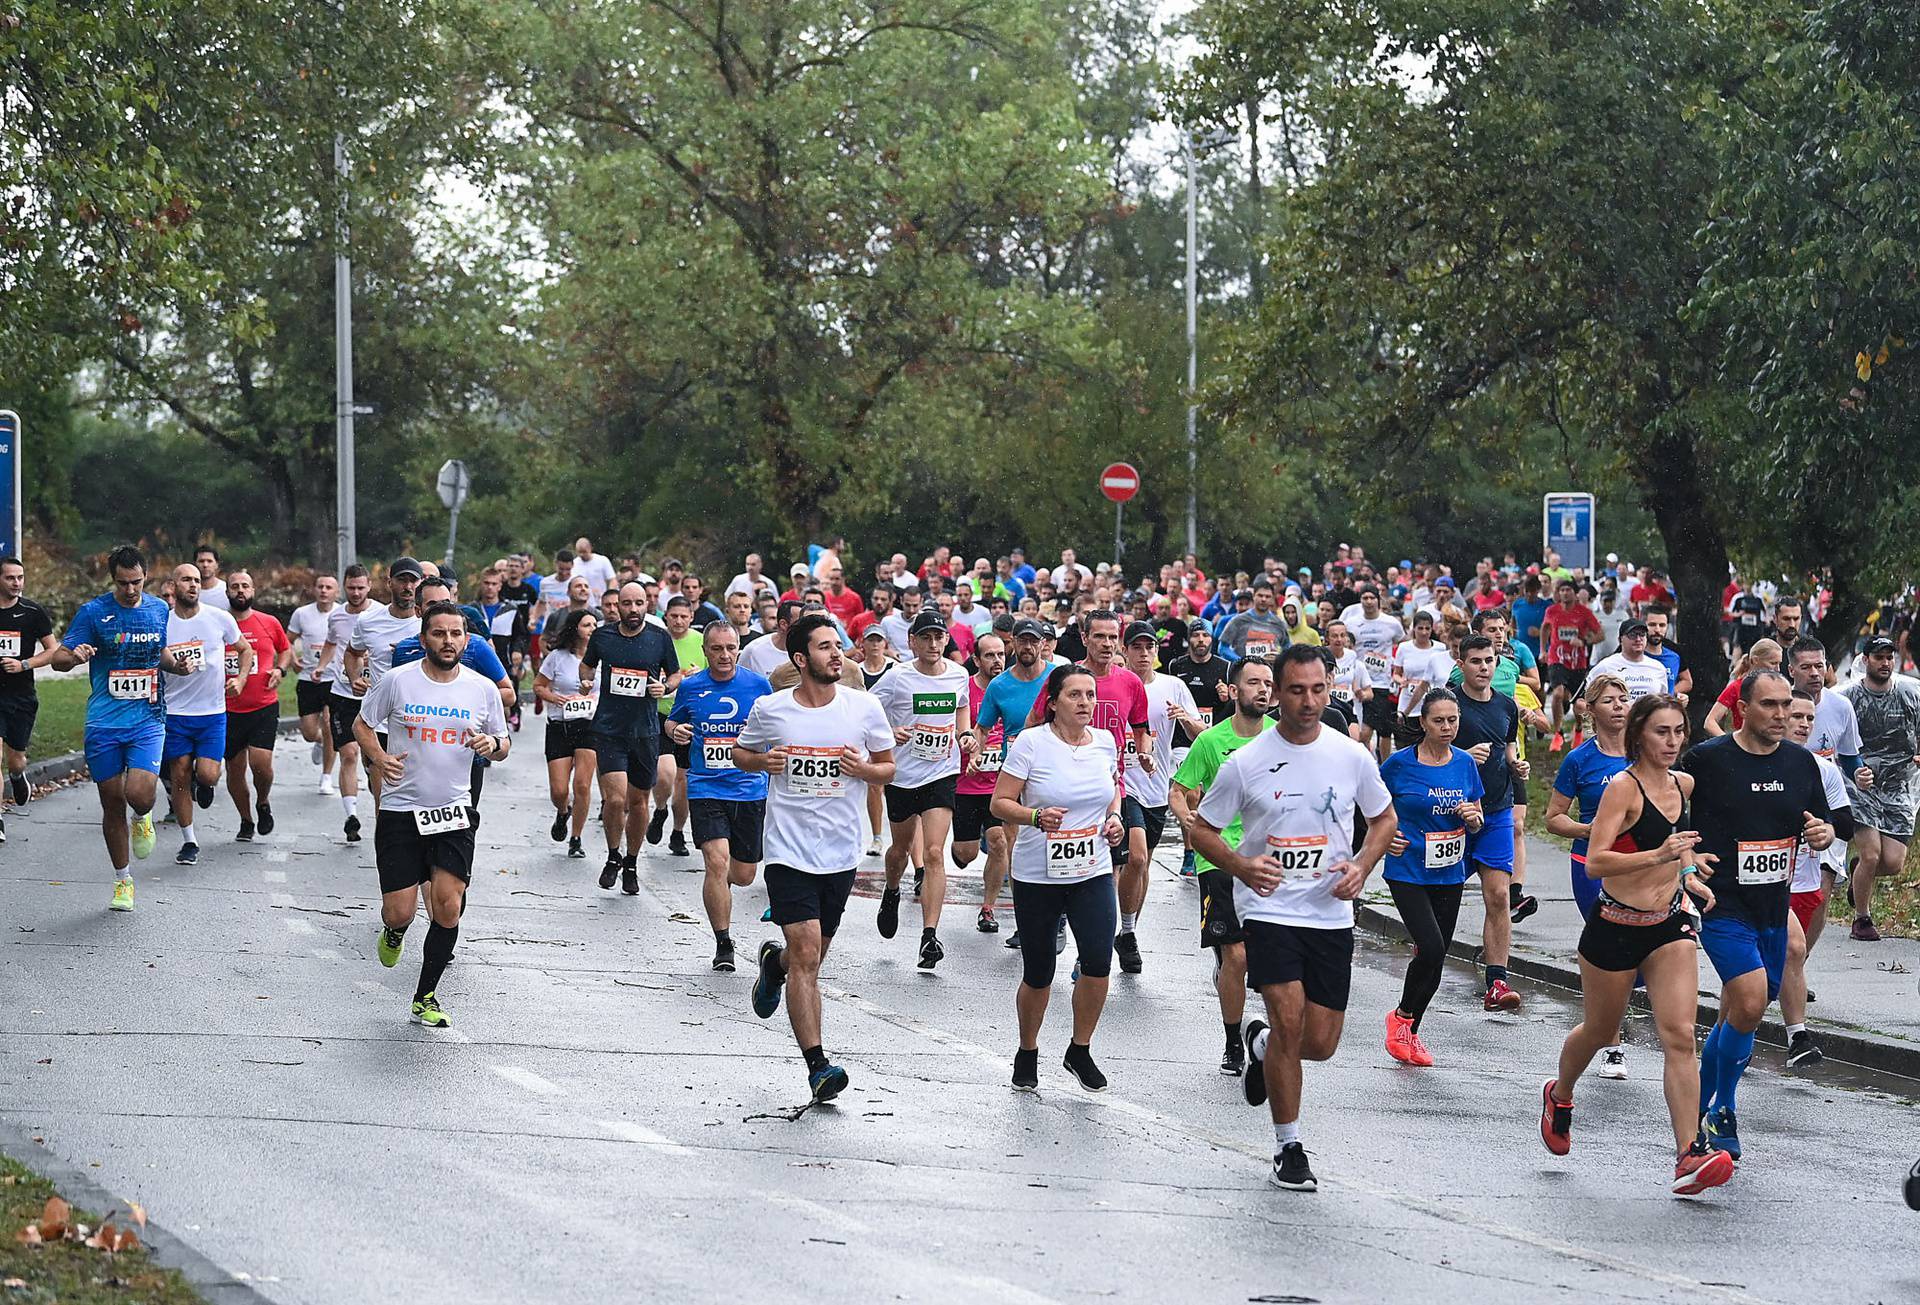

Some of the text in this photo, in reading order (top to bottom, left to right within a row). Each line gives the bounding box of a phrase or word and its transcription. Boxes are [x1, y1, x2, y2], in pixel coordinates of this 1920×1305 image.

[131, 633, 160, 643] HOPS
[1250, 646, 1266, 654] 890
[1365, 656, 1385, 669] 4044
[112, 679, 146, 692] 1411
[616, 677, 640, 690] 427
[565, 701, 592, 713] 4947
[918, 700, 953, 708] PEVEX
[701, 722, 746, 733] Dechra
[915, 732, 949, 748] 3919
[792, 758, 840, 778] 2635
[1763, 780, 1784, 791] safu
[1428, 788, 1463, 797] Allianz
[418, 805, 463, 826] 3064
[1051, 838, 1094, 860] 2641
[1435, 840, 1461, 859] 389
[1743, 852, 1787, 873] 4866
